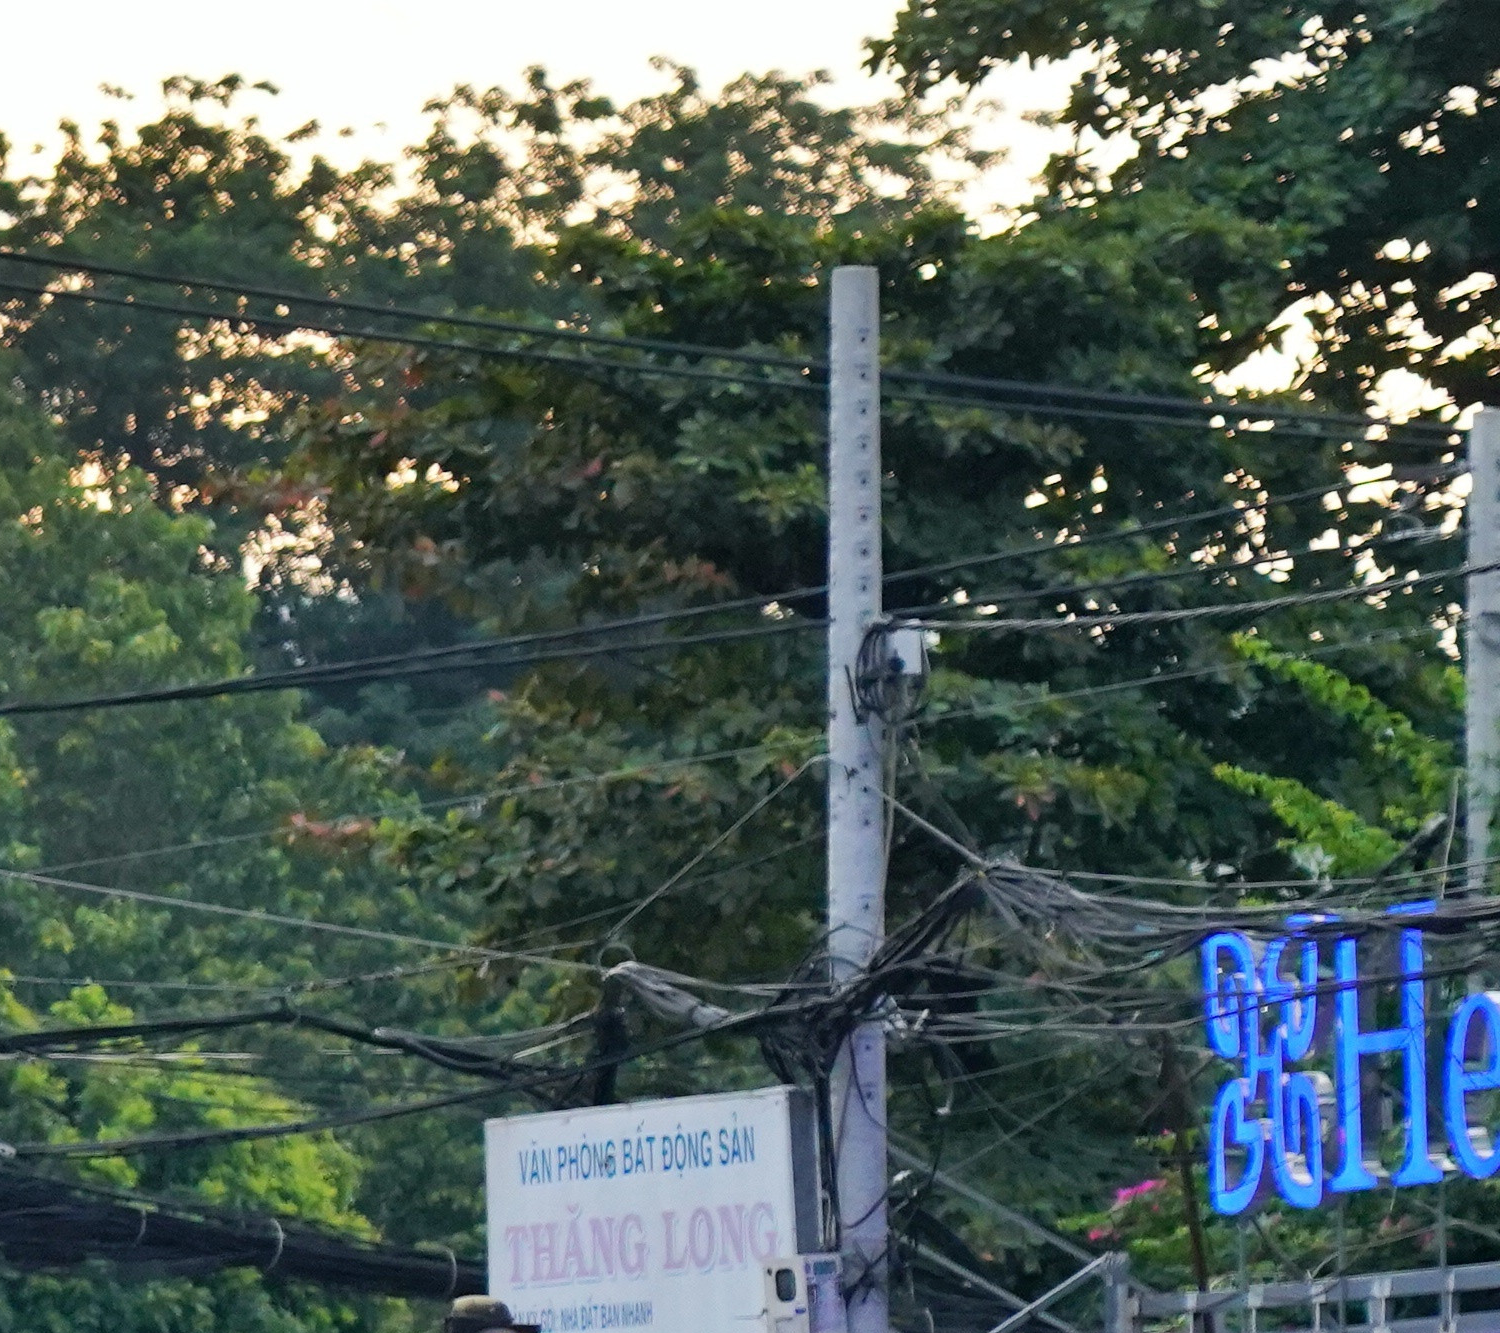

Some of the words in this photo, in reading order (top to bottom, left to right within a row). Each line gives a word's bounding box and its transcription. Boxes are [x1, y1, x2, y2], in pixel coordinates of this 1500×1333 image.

[518, 1138, 553, 1186] VĂN
[622, 1119, 656, 1175] BẤT
[661, 1123, 712, 1179] ĐỘNG
[718, 1111, 756, 1166] SẢN
[505, 1203, 648, 1286] THĂNG
[661, 1201, 781, 1274] LONG
